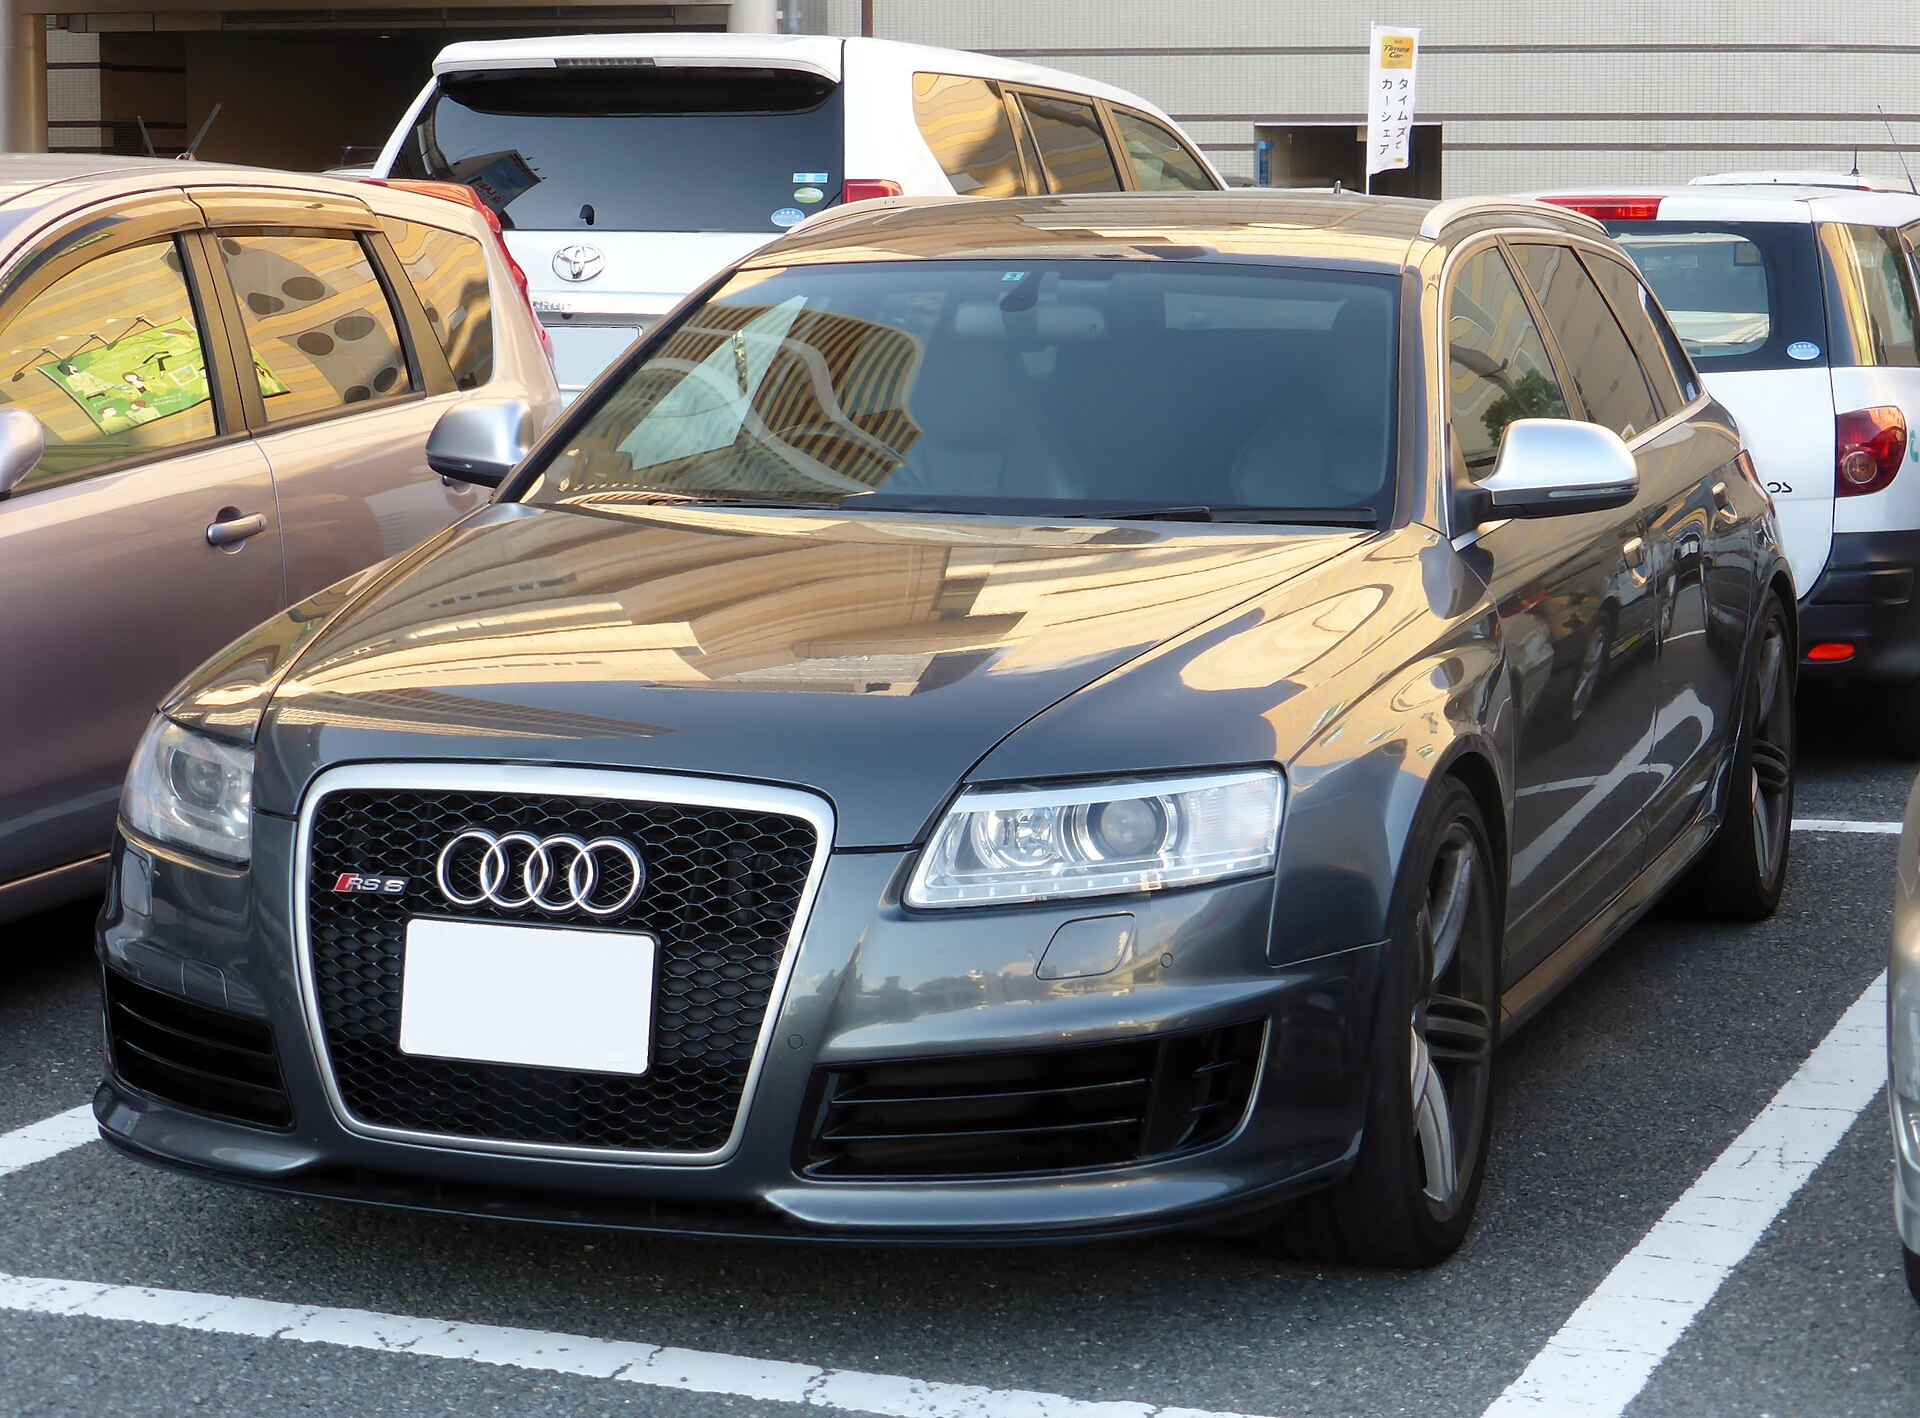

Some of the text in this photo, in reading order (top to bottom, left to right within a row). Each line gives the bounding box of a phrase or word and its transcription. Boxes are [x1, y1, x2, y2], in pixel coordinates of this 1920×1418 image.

[1379, 78, 1393, 155] カーシェア
